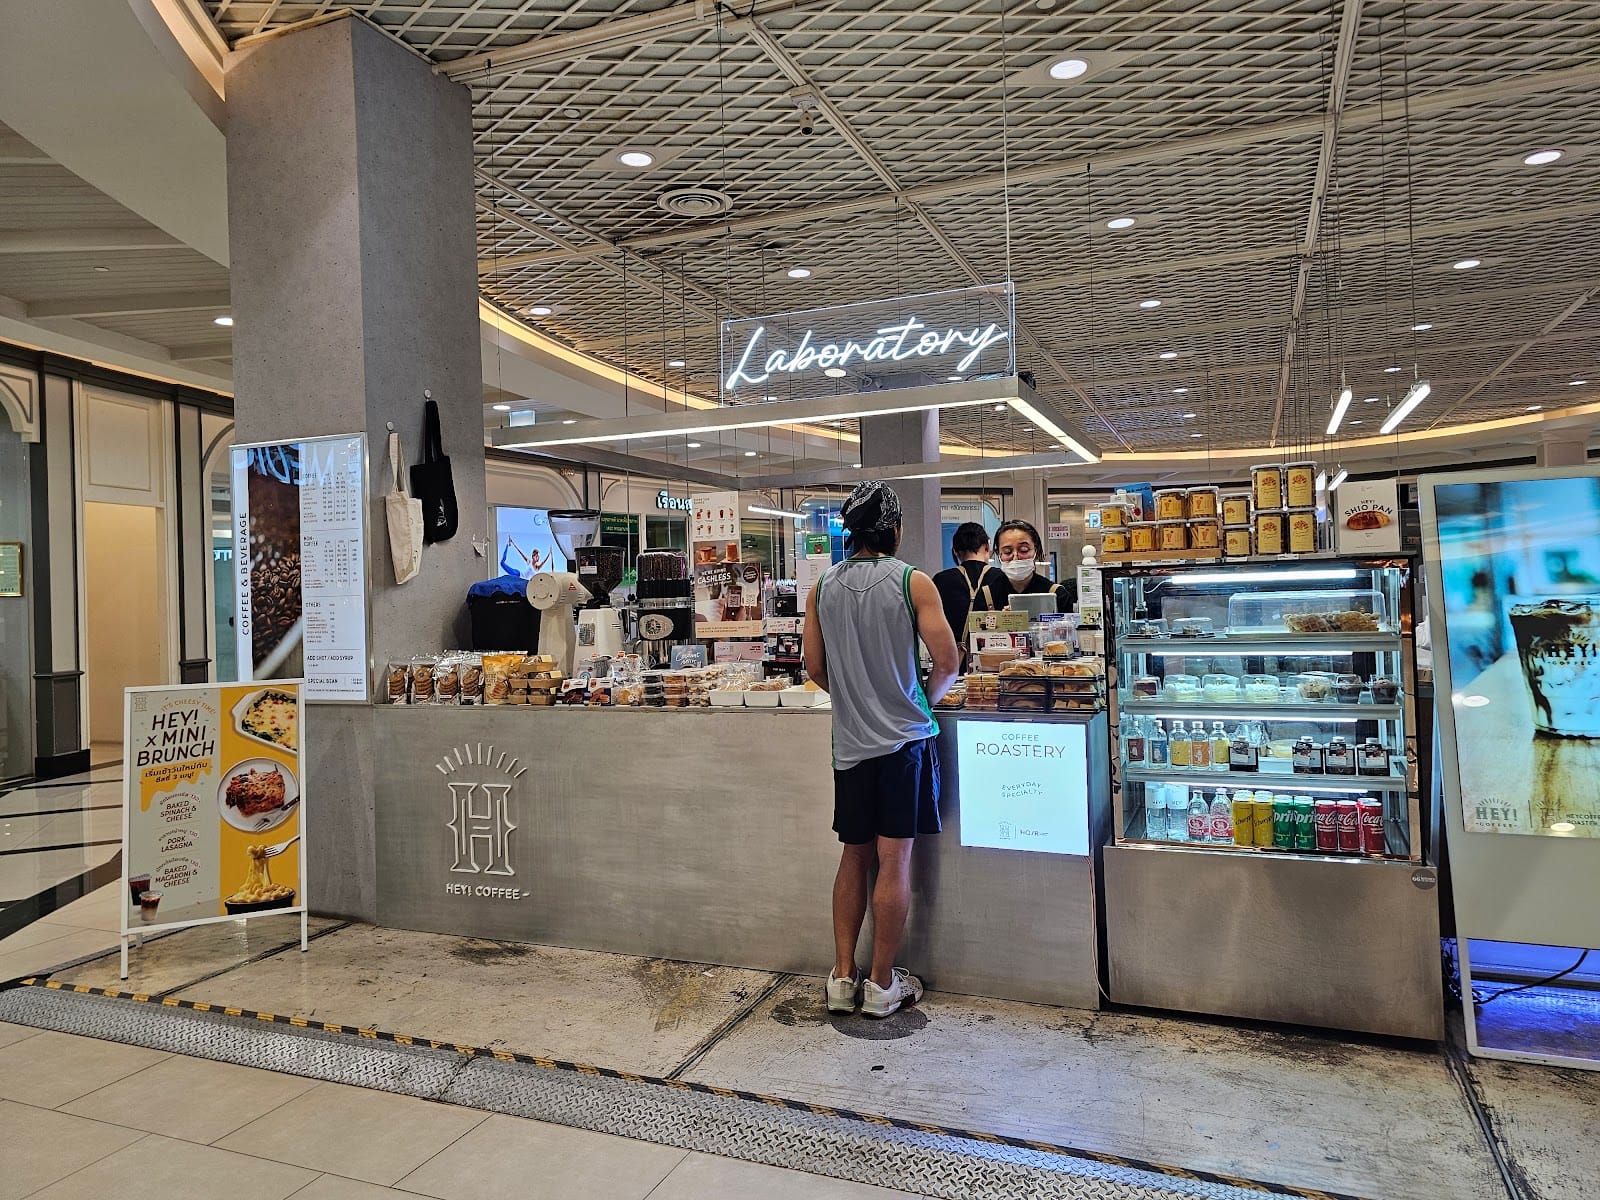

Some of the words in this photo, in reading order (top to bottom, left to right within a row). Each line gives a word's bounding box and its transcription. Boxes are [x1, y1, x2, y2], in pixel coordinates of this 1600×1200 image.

[725, 316, 1009, 390] Laboratory
[1344, 504, 1369, 517] SHIO
[1372, 504, 1393, 515] PAN
[239, 511, 248, 575] BEVERAGE
[241, 579, 248, 587] &
[697, 572, 731, 585] CASHLESS
[241, 591, 250, 636] COFFEE
[152, 709, 198, 731] HEY!
[162, 725, 207, 747] MINI
[1001, 733, 1040, 742] COFFEE
[137, 740, 215, 767] BRUNCH
[976, 742, 1066, 759] ROASTERY
[1001, 781, 1042, 791] EVERYDAY
[1001, 788, 1043, 798] SPECIALTY
[166, 800, 190, 810] BAKED
[160, 807, 190, 818] SPINACH
[166, 813, 192, 822] CHEESE
[1475, 806, 1518, 822] HEY!
[161, 841, 193, 852] LASAGNA
[167, 836, 186, 845] PORK
[164, 864, 188, 875] BAKED
[155, 870, 191, 883] MACARONI
[163, 876, 190, 888] CHEESE
[446, 883, 472, 896] HEY!
[475, 886, 521, 900] COFFEE
